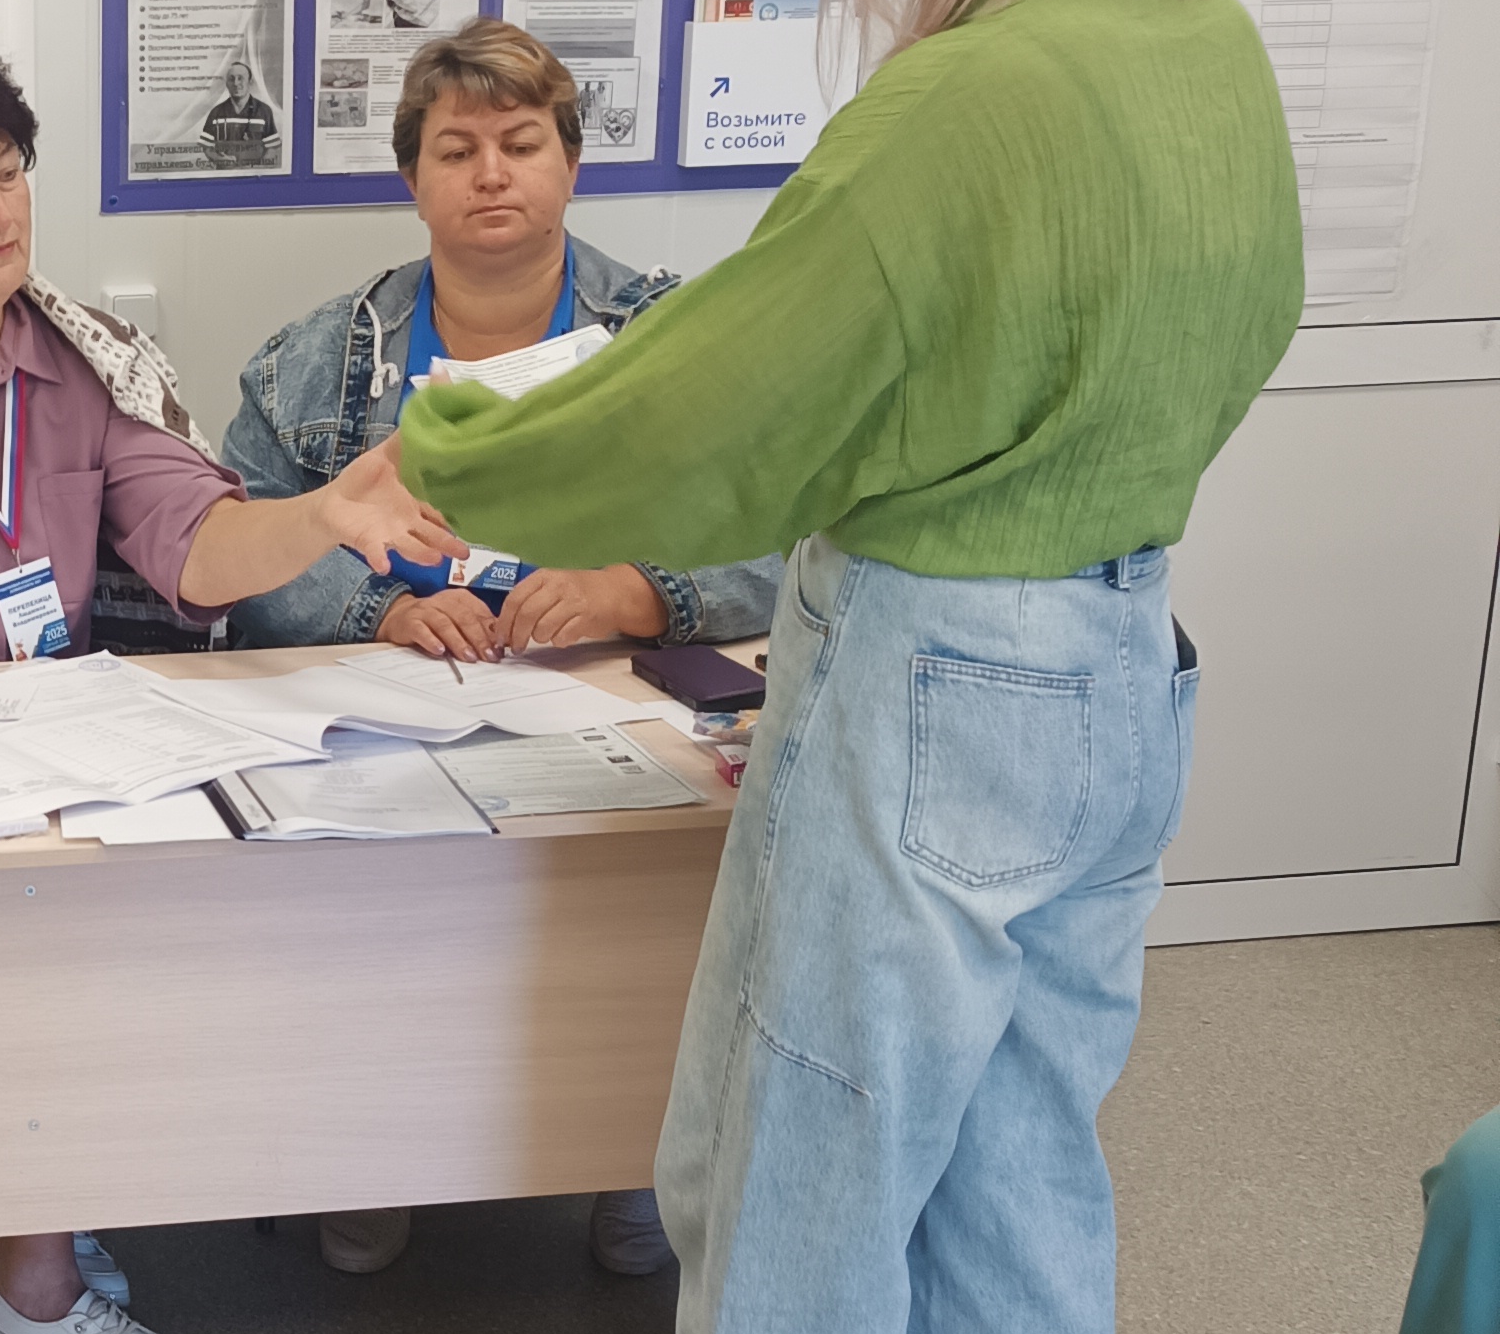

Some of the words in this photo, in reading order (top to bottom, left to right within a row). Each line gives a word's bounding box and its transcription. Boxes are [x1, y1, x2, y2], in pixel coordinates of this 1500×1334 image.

[706, 111, 806, 128] Возьмите
[704, 136, 715, 150] с
[722, 131, 785, 149] собой
[490, 566, 517, 581] 2025
[45, 625, 68, 642] 2025
